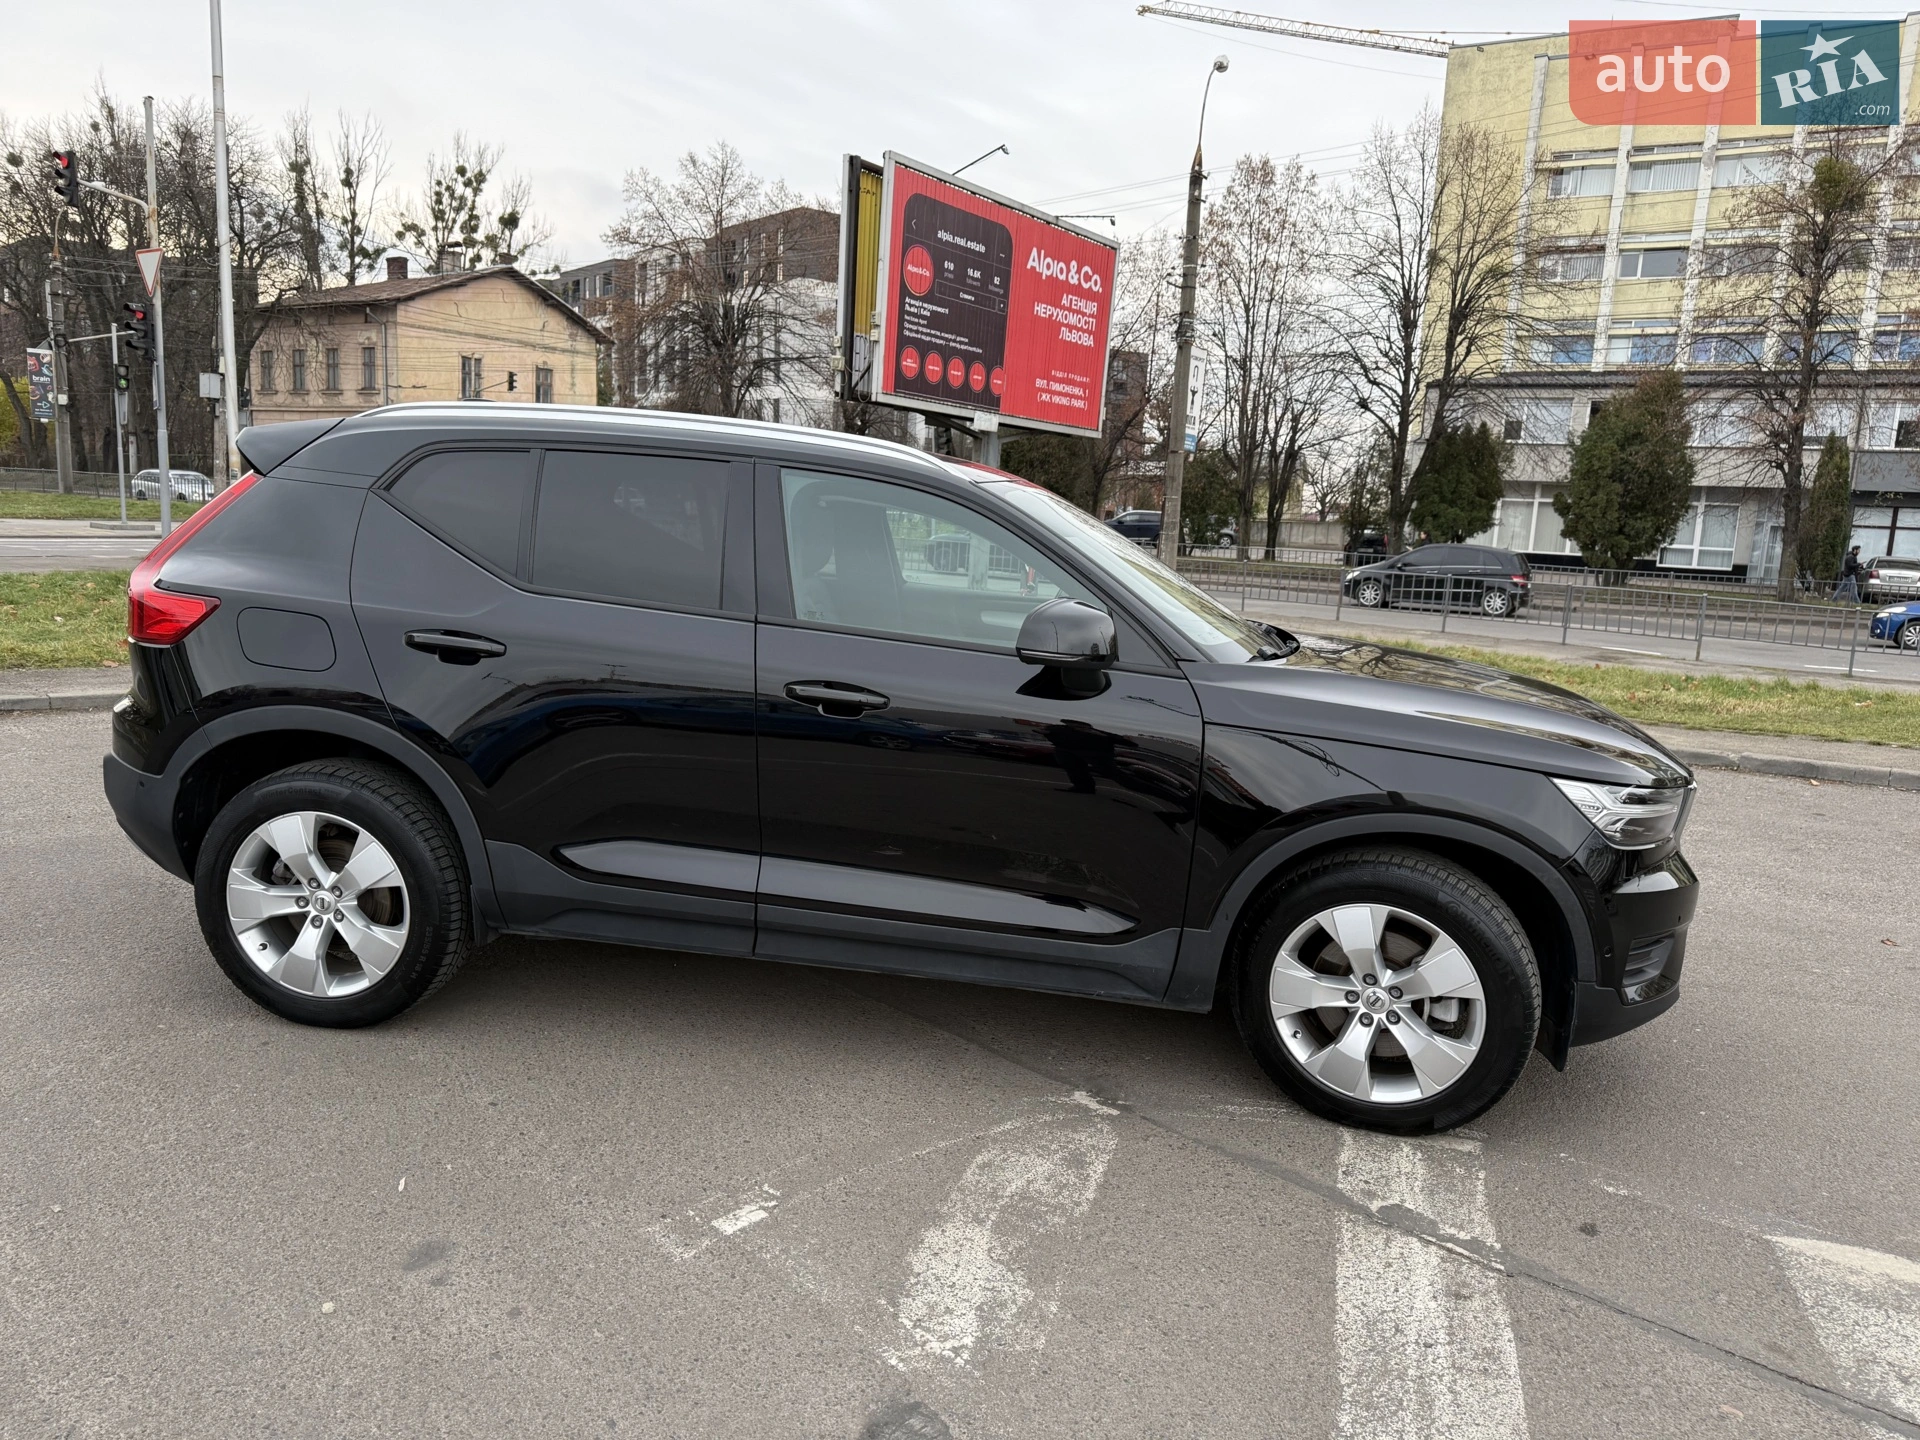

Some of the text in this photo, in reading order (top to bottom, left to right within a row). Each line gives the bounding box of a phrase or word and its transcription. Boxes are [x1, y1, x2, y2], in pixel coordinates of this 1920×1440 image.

[937, 229, 986, 253] alpia.real.estate
[1061, 293, 1097, 315] АГЕНЦІЯ
[1034, 301, 1096, 331] НЕРУХОМОСТІ
[1059, 326, 1094, 347] ЛЬВОВА
[1035, 378, 1048, 389] ВУЛ.
[1049, 381, 1085, 397] ПИМОНЕНКА,
[1051, 394, 1071, 406] VIKING
